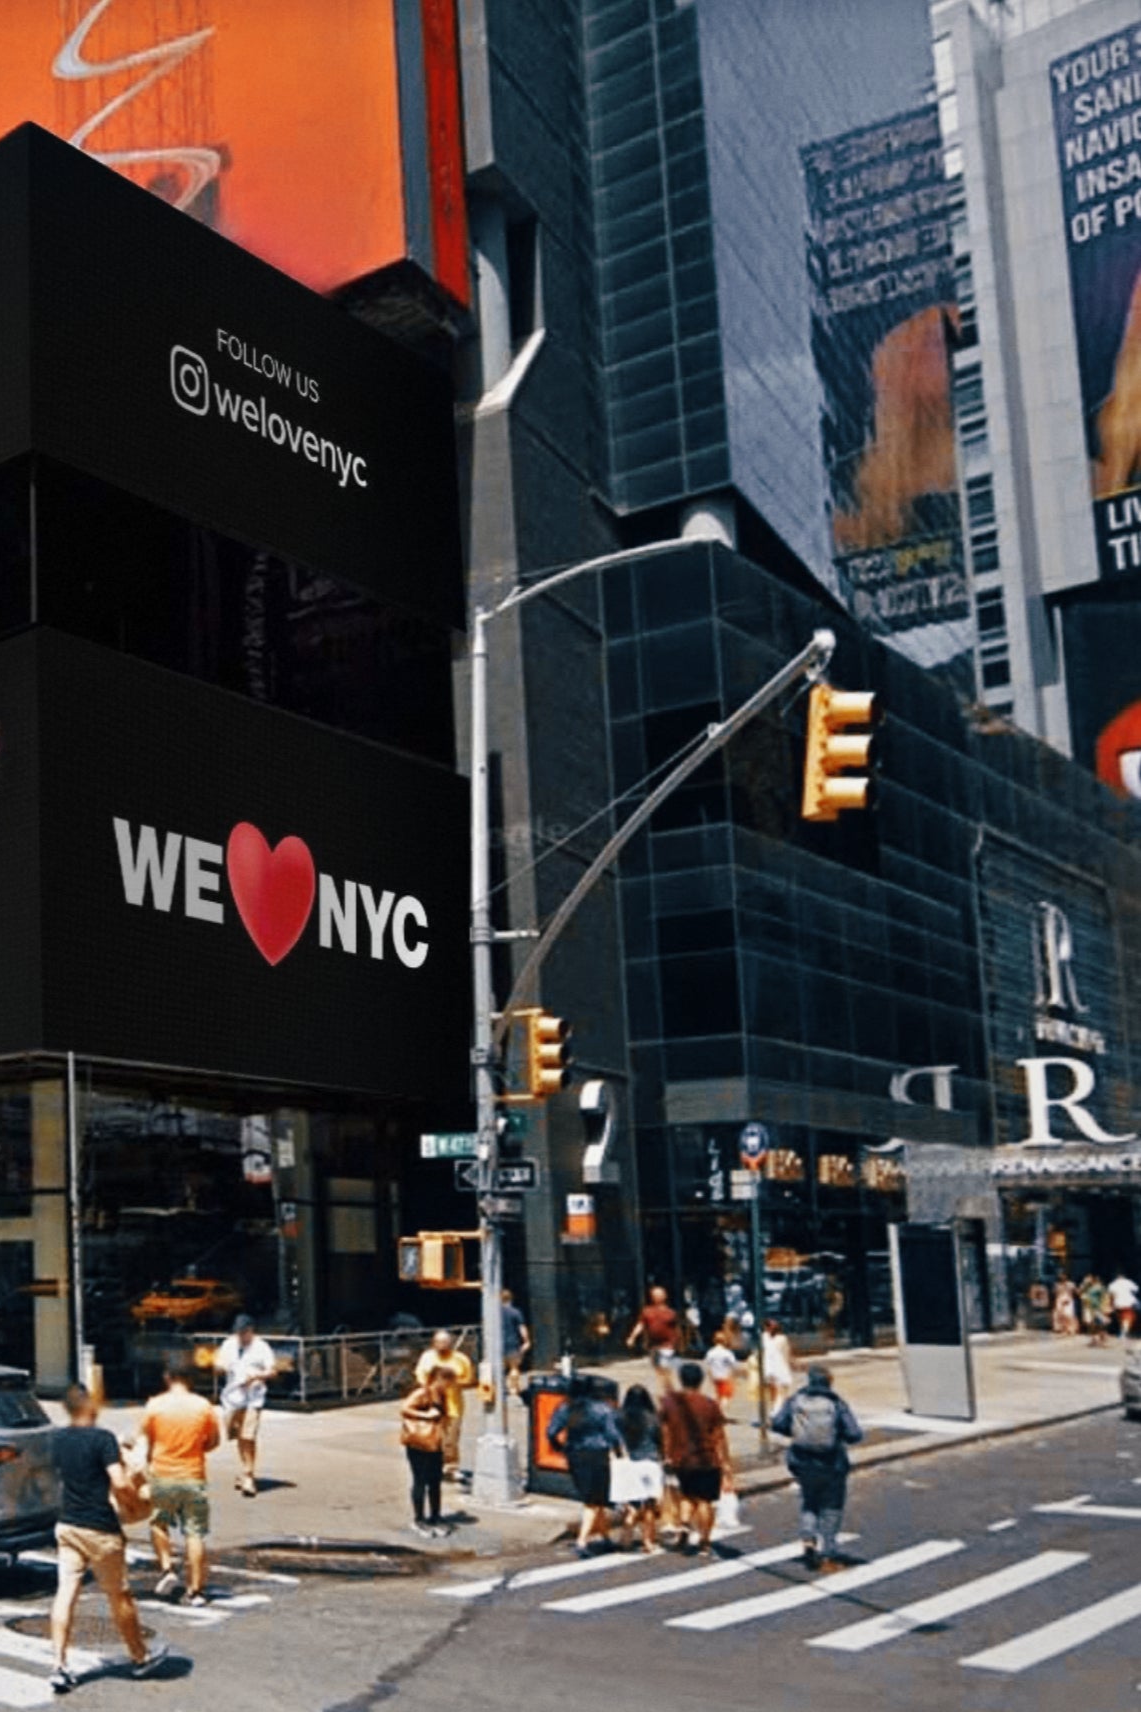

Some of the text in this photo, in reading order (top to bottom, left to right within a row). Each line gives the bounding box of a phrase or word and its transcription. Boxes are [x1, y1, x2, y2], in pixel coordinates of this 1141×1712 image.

[1052, 38, 1129, 93] YOUR
[1071, 203, 1107, 243] OF
[217, 327, 320, 403] FOLLOW US
[214, 382, 368, 488] welovenyc
[113, 816, 429, 969] WE NYC
[1015, 1056, 1137, 1149] R
